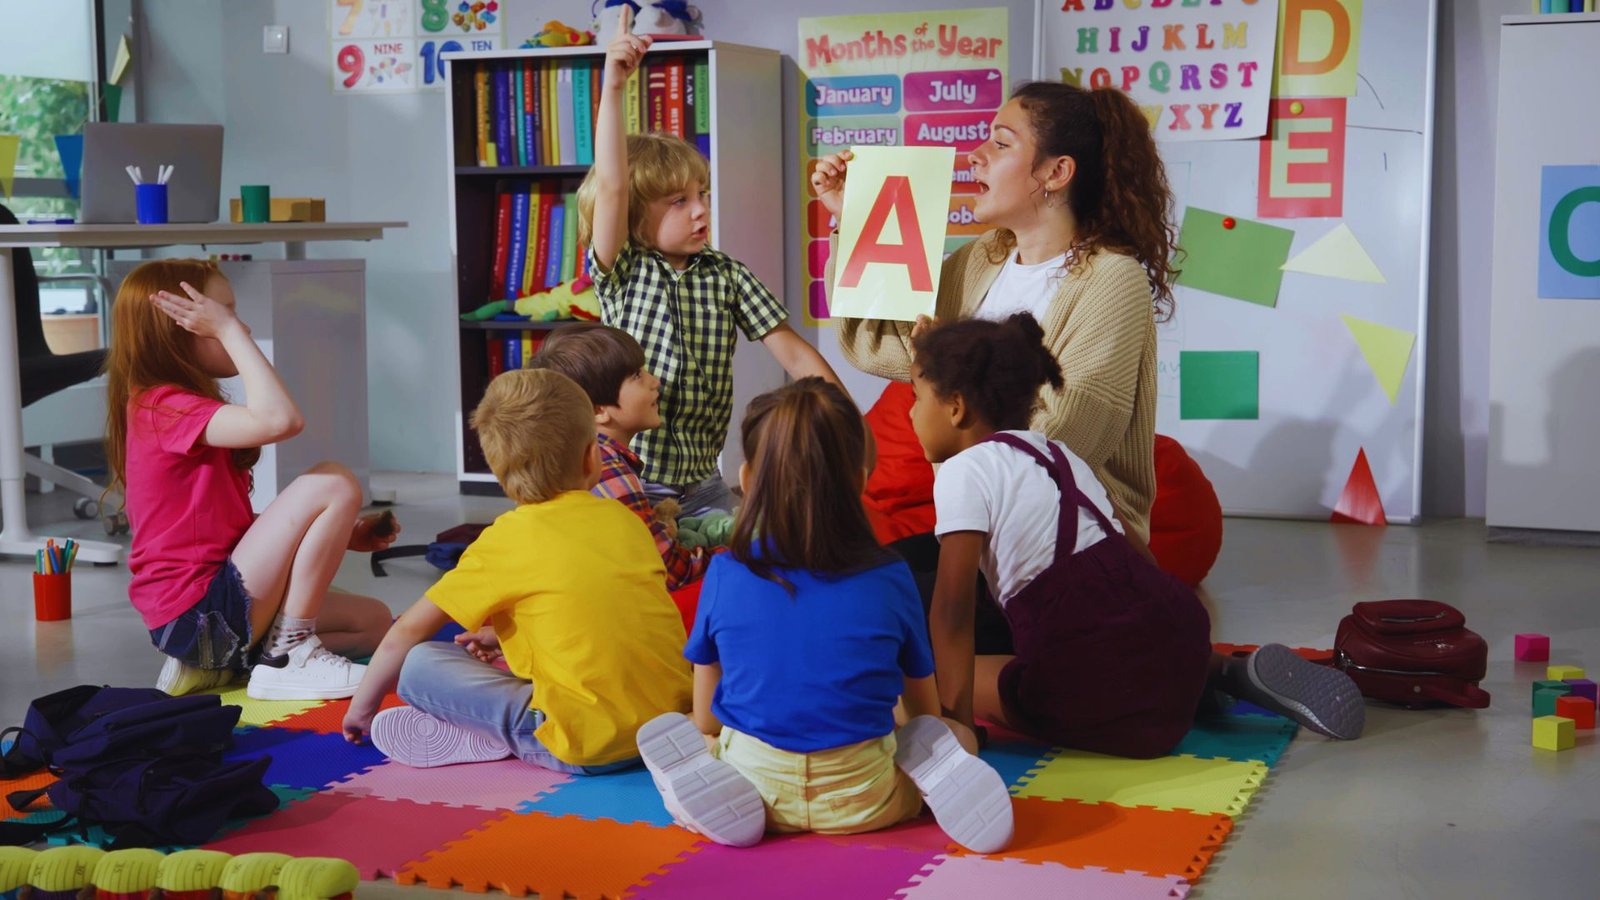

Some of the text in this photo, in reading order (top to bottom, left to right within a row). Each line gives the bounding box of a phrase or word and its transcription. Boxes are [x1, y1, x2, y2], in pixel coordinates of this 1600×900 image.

[336, 0, 363, 36] 7
[421, 0, 449, 33] 8
[915, 22, 929, 36] of
[373, 43, 404, 55] NINE
[471, 40, 493, 52] TEN
[806, 30, 906, 67] Months
[911, 36, 935, 54] the
[937, 24, 1003, 60] Year
[1076, 21, 1248, 53] H I J K L M
[1281, 0, 1351, 76] D
[337, 44, 365, 89] 9
[1060, 67, 1084, 89] N
[1121, 66, 1140, 91] P
[1148, 61, 1171, 93] Q
[1180, 64, 1201, 90] R
[1209, 63, 1228, 89] S
[1237, 62, 1258, 87] T
[814, 85, 893, 107] January
[929, 80, 976, 104] July
[917, 120, 990, 143] August
[1169, 104, 1191, 130] X
[1198, 104, 1219, 130] Y
[1224, 102, 1243, 128] Z
[811, 127, 898, 147] February
[1269, 117, 1334, 198] E
[838, 175, 934, 292] A
